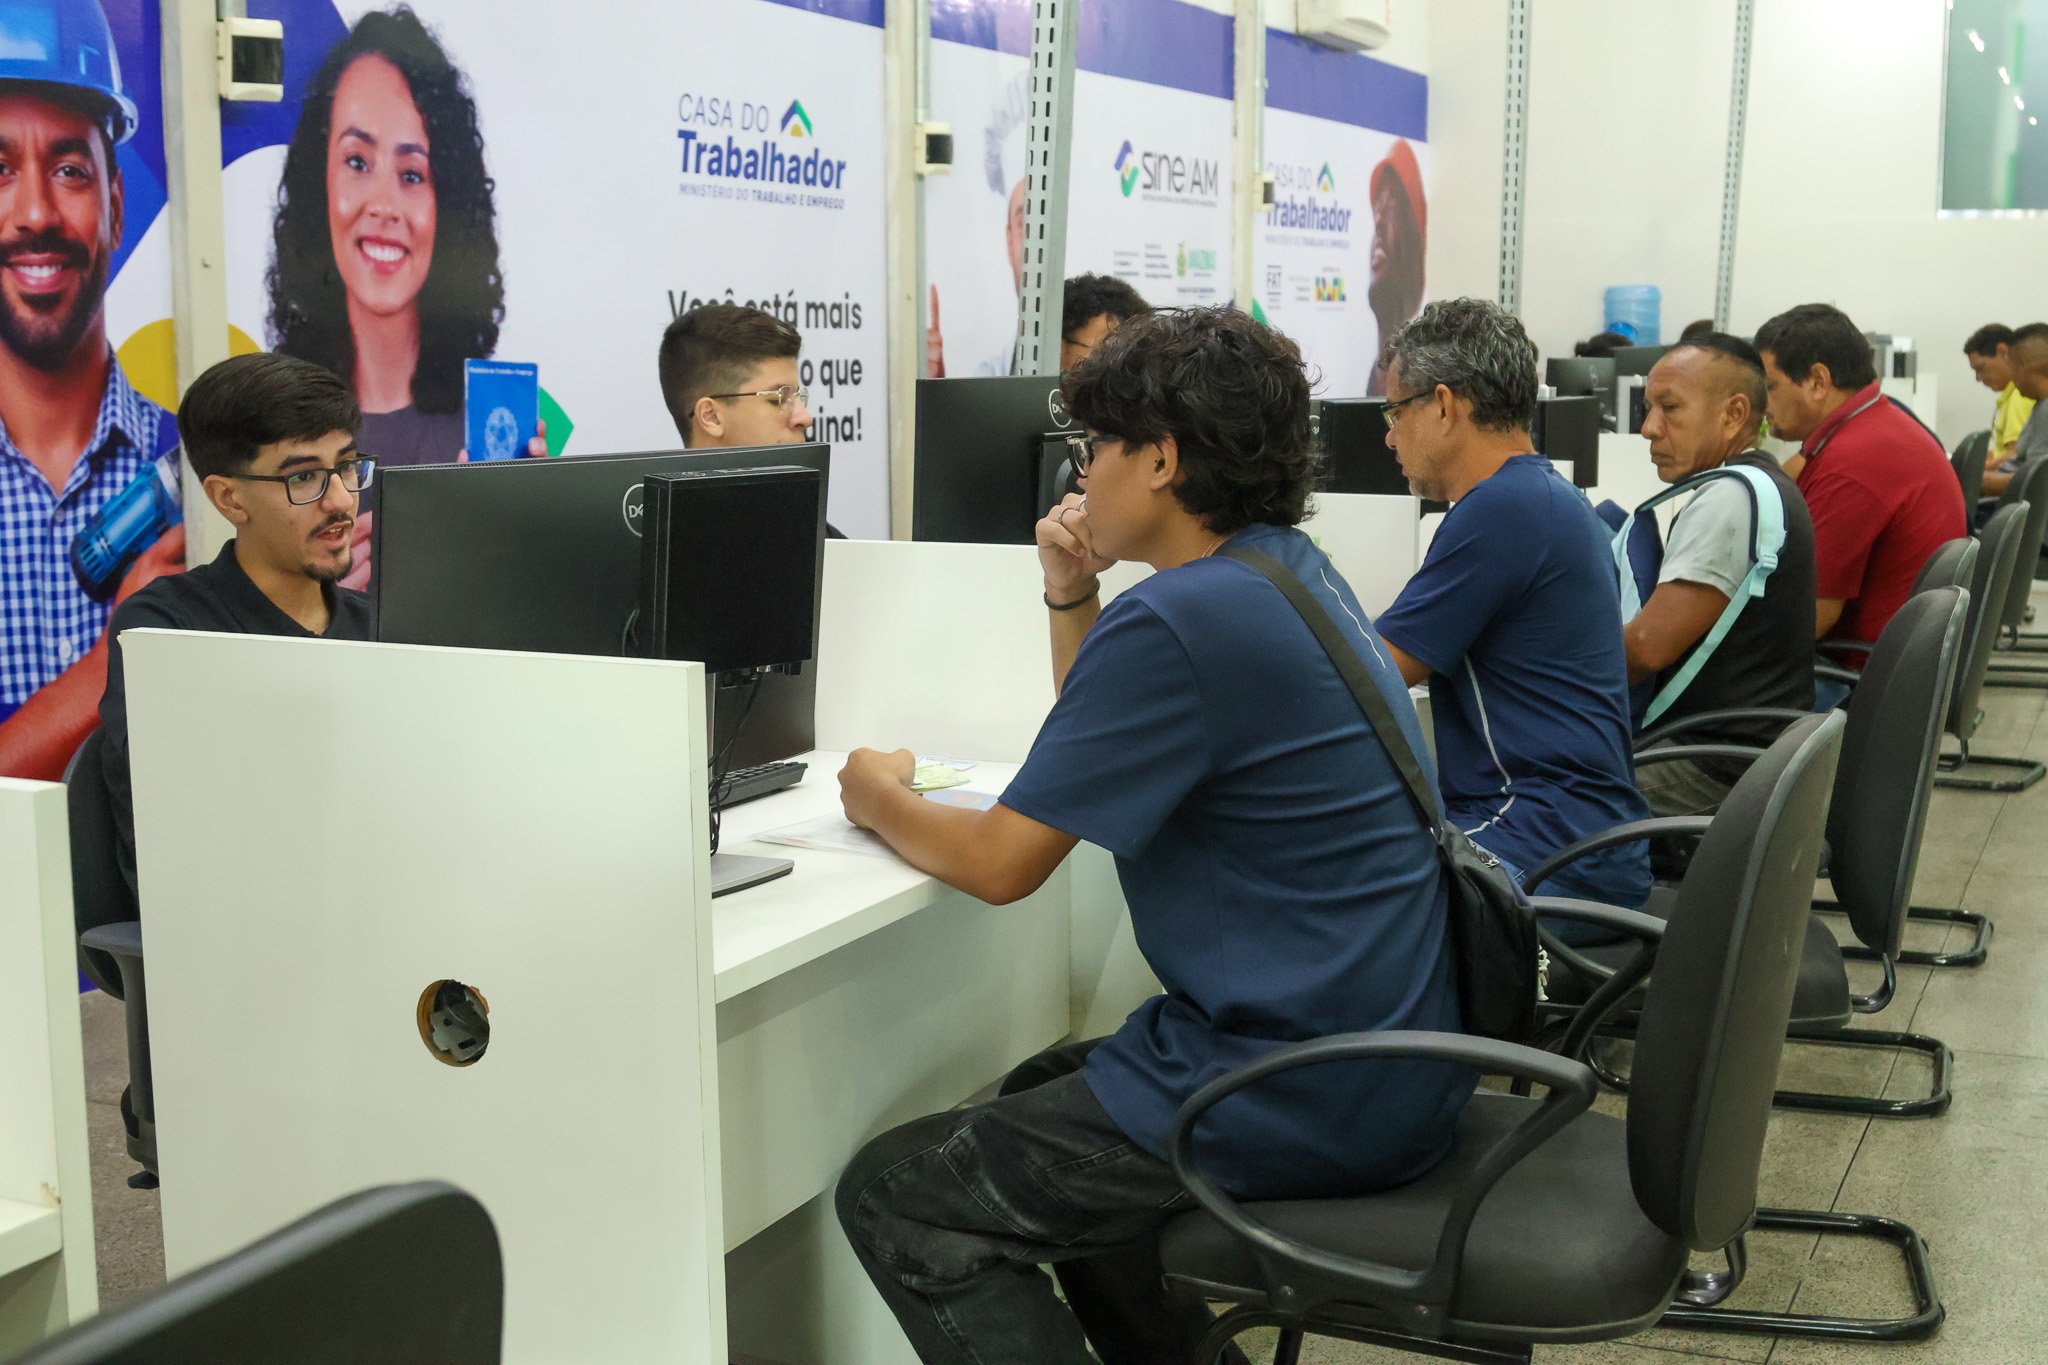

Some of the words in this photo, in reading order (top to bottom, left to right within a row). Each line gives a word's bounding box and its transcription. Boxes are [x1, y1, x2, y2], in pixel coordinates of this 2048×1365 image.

[678, 93, 733, 128] CASA
[741, 102, 769, 133] DO
[677, 129, 847, 190] Trabalhador
[736, 187, 750, 200] DO
[752, 189, 798, 206] TRABALHO
[799, 194, 804, 207] E
[806, 195, 846, 210] EMPREGO
[805, 290, 862, 330] mais
[820, 359, 862, 398] que
